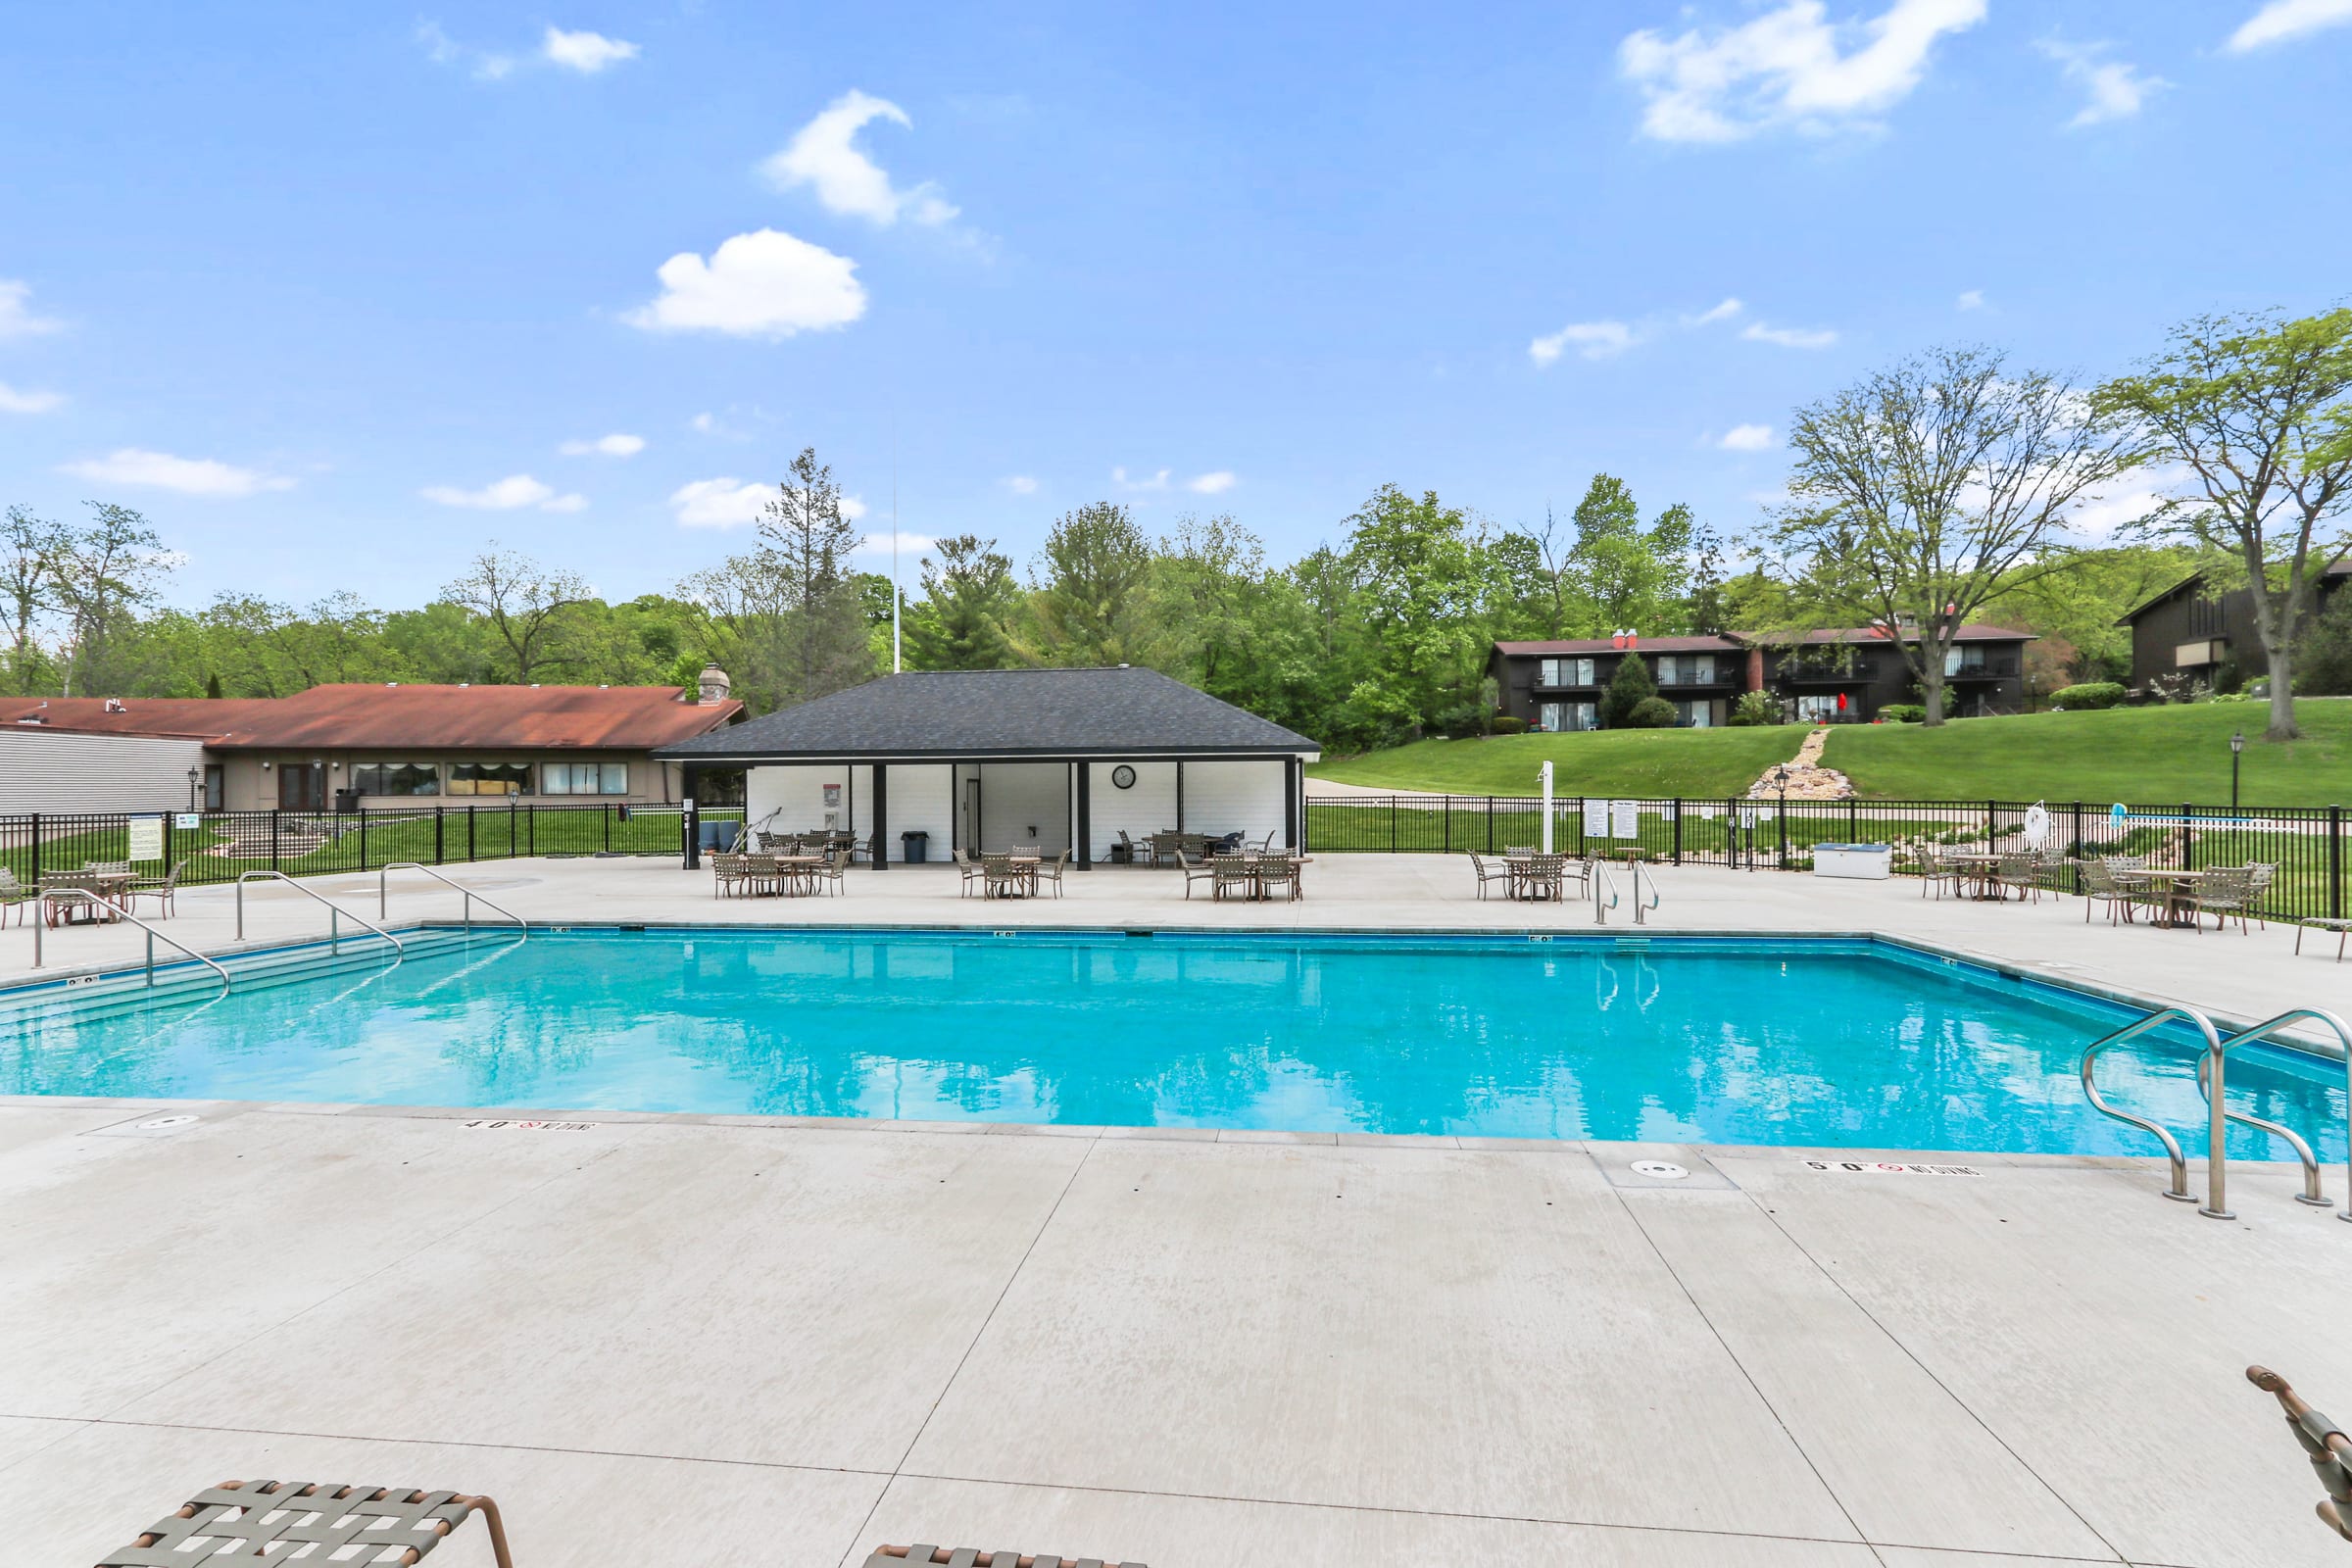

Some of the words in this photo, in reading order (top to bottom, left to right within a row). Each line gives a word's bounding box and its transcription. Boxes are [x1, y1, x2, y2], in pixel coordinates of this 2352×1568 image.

[1805, 1161, 1828, 1170] 5
[1840, 1162, 1863, 1171] 0
[1907, 1164, 1932, 1174] NO
